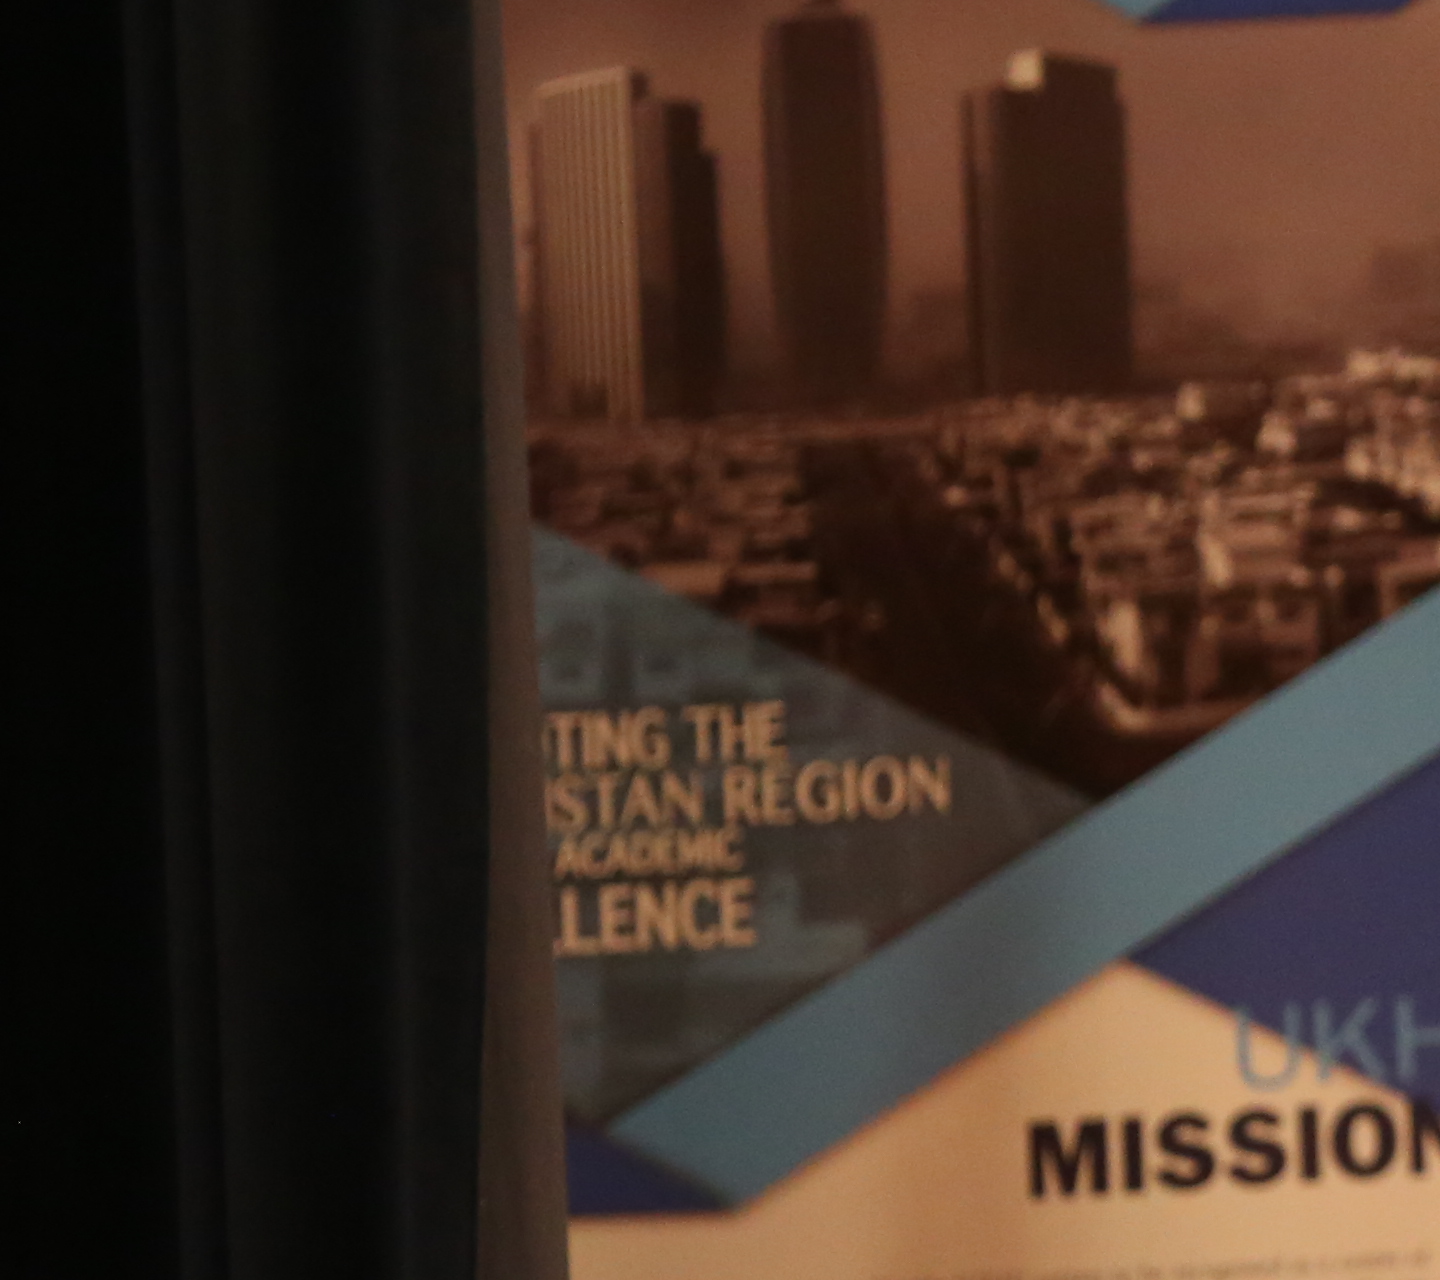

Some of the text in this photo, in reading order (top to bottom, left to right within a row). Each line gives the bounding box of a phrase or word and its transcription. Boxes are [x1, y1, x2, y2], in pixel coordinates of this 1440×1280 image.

[542, 700, 788, 769] TING THE
[722, 752, 954, 828] REGION
[554, 828, 746, 878] ACADEMIC
[553, 880, 758, 956] LENCE
